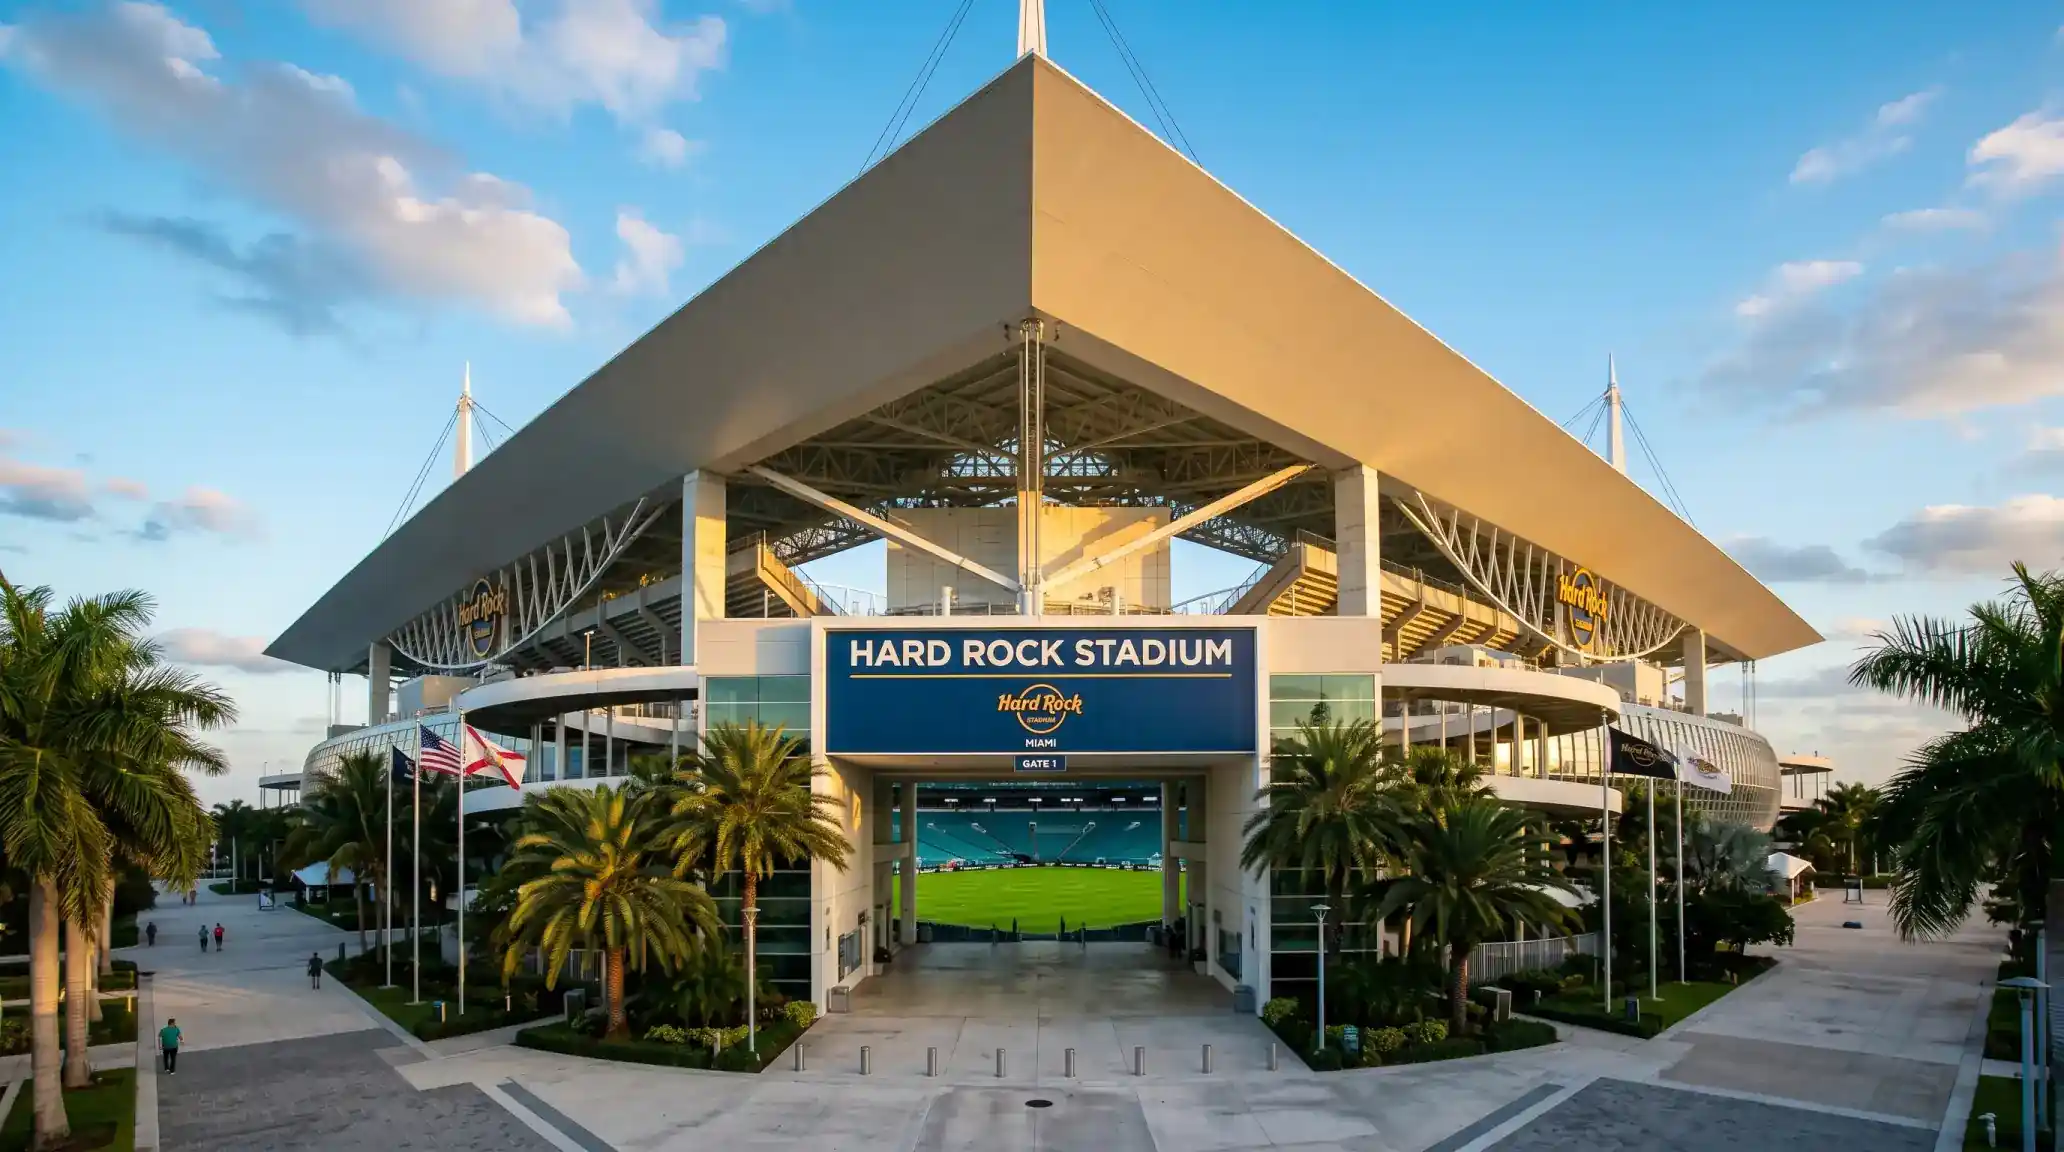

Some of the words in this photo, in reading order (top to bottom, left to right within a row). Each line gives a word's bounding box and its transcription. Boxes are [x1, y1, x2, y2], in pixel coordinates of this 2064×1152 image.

[459, 595, 480, 625] Hard
[481, 588, 504, 621] Rock
[1560, 575, 1586, 609] Hard
[1585, 586, 1608, 624] Rock
[850, 639, 952, 667] HARD
[963, 639, 1065, 667] ROCK
[1074, 639, 1232, 666] STADIUM
[998, 694, 1041, 711] Hard
[1042, 694, 1083, 715] Rock
[1025, 739, 1057, 748] MIAMI
[1022, 759, 1050, 768] GATE
[1052, 759, 1057, 768] 1
